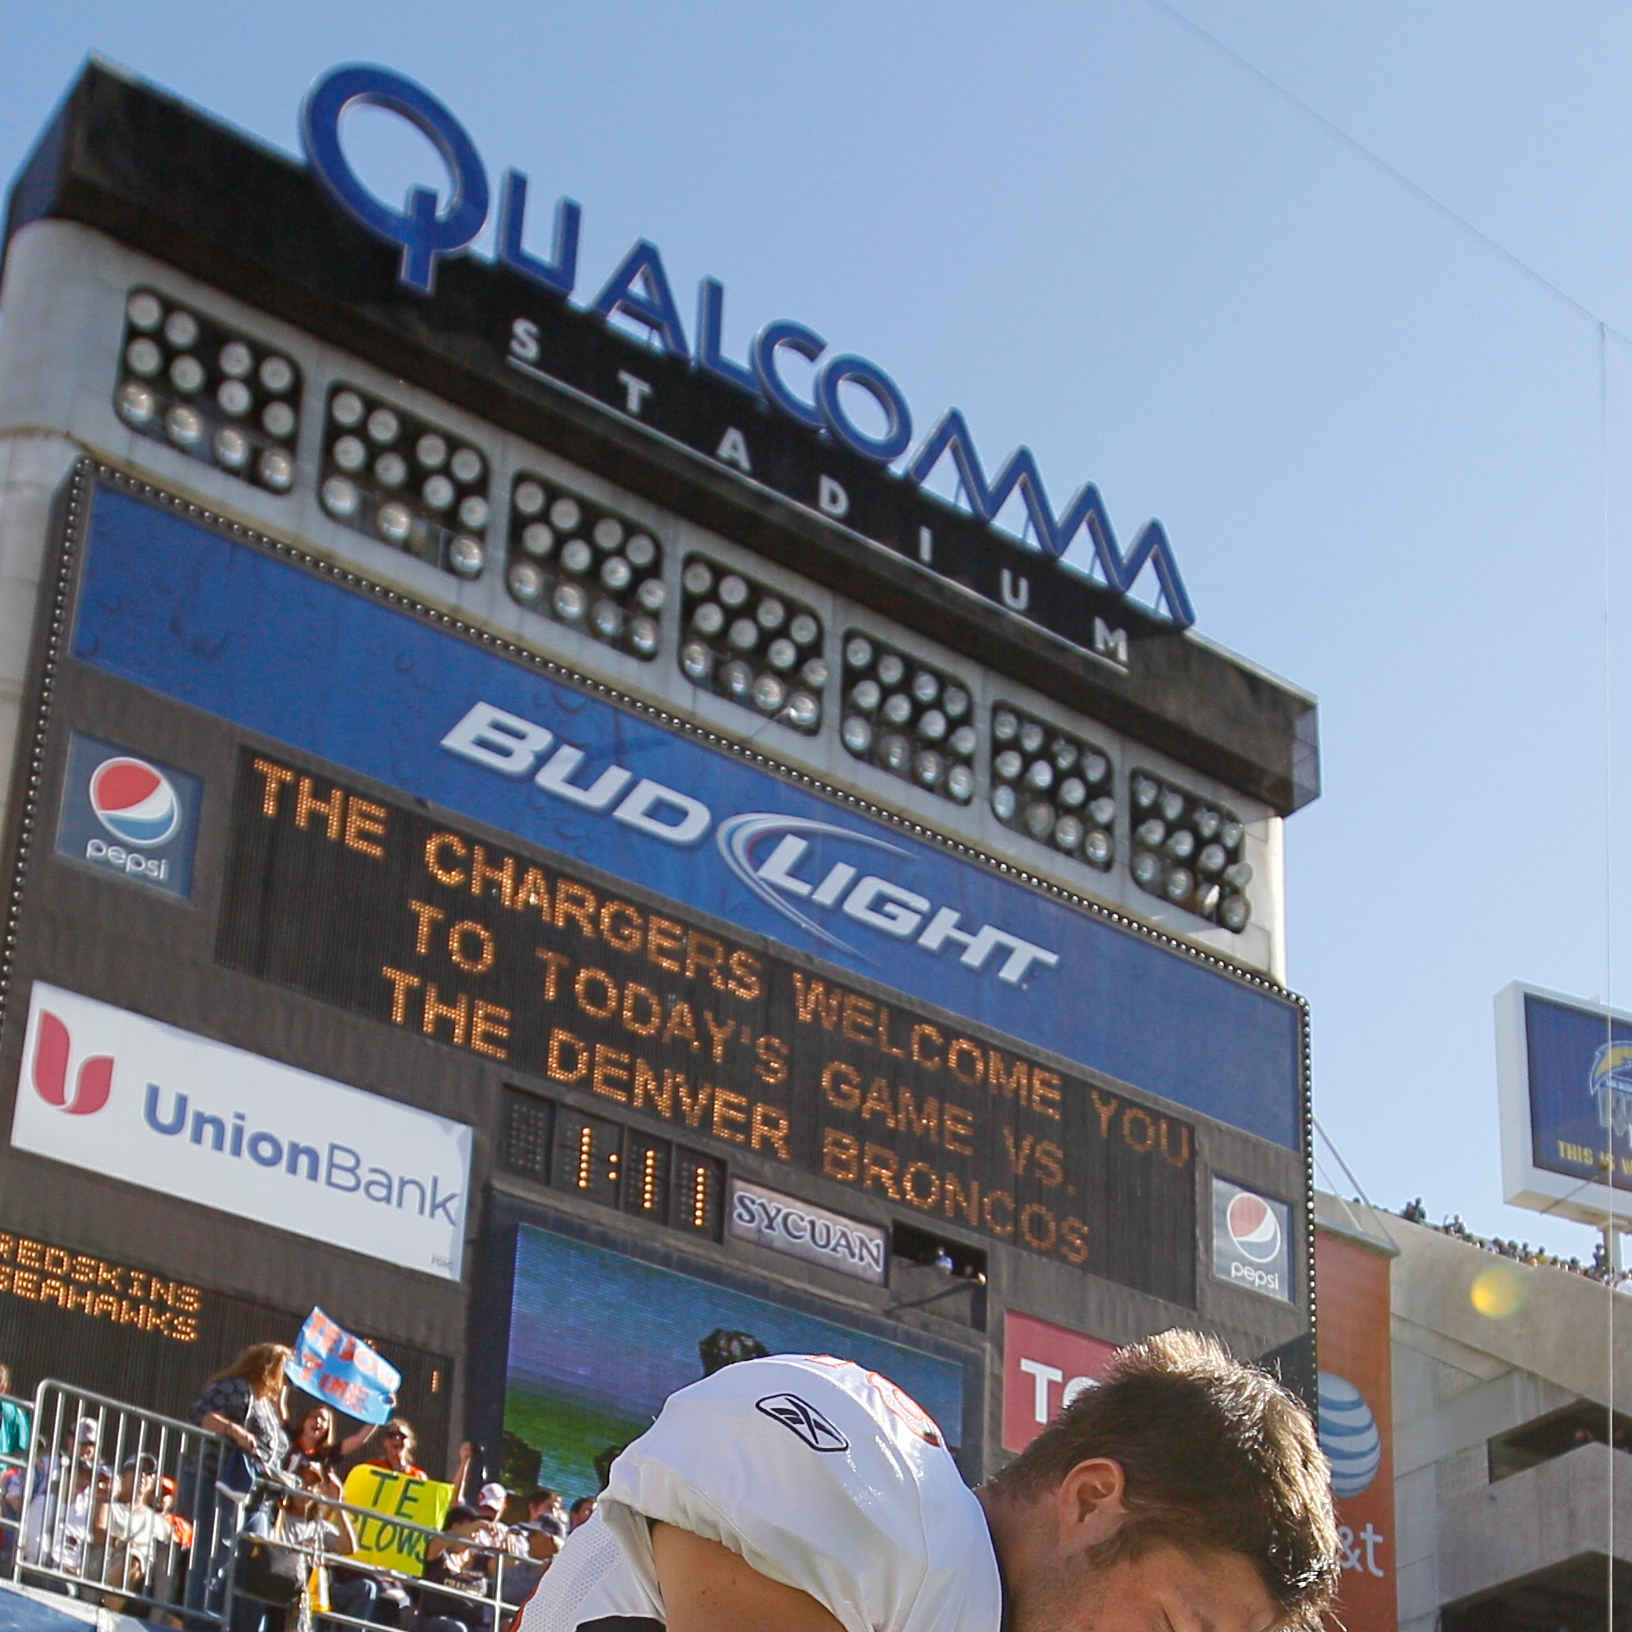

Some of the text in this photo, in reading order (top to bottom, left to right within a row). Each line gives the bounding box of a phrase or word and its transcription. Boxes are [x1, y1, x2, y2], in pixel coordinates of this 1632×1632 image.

[299, 60, 1196, 629] QUALCOMM
[509, 317, 1128, 663] STADIUM
[84, 838, 168, 883] pepsi
[440, 700, 1060, 986] BUD LIGHT
[253, 757, 1190, 1169] THE CHARGERS WELCOME YOU
[407, 899, 497, 975] TO
[534, 946, 791, 1086] TODAY'S
[820, 1060, 976, 1157] GAME
[141, 1082, 459, 1228] UnionBank
[381, 964, 1091, 1265] THE DENVER BRONCOS
[575, 1126, 707, 1227] 1:11
[1557, 1139, 1594, 1166] THIS
[733, 1191, 884, 1273] SYCUAN
[1230, 1260, 1281, 1291] pepsi
[348, 1512, 432, 1565] LOWS
